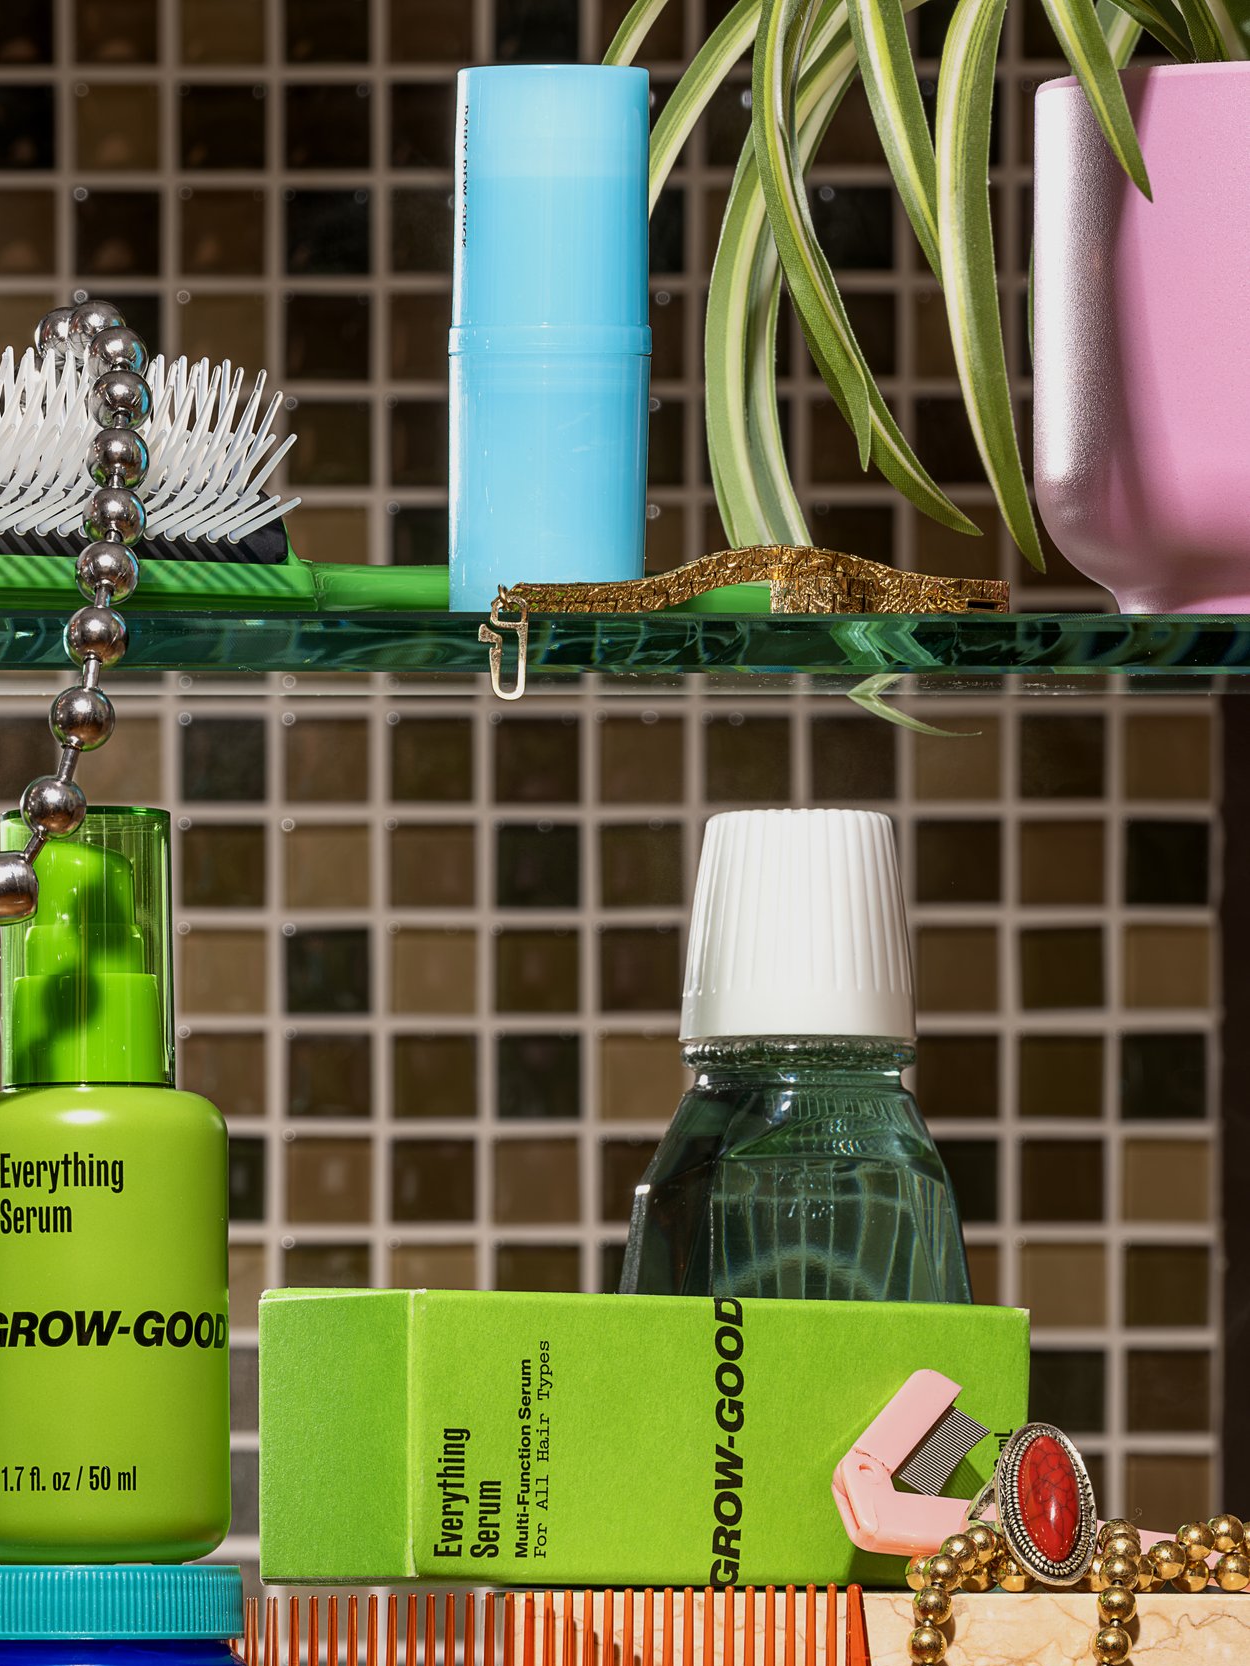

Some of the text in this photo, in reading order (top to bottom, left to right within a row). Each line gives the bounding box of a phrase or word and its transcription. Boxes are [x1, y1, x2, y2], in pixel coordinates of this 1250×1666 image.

[0, 1151, 124, 1194] Everything
[0, 1198, 73, 1235] Serum
[1, 1465, 137, 1492] 1.7 fl. oz / 50 ml
[433, 1427, 472, 1558] Everything
[514, 1359, 532, 1558] Multi-Function Serum
[533, 1340, 553, 1559] For All Hair Types
[709, 1296, 745, 1586] GROW-GOOD
[469, 1479, 502, 1559] Serum
